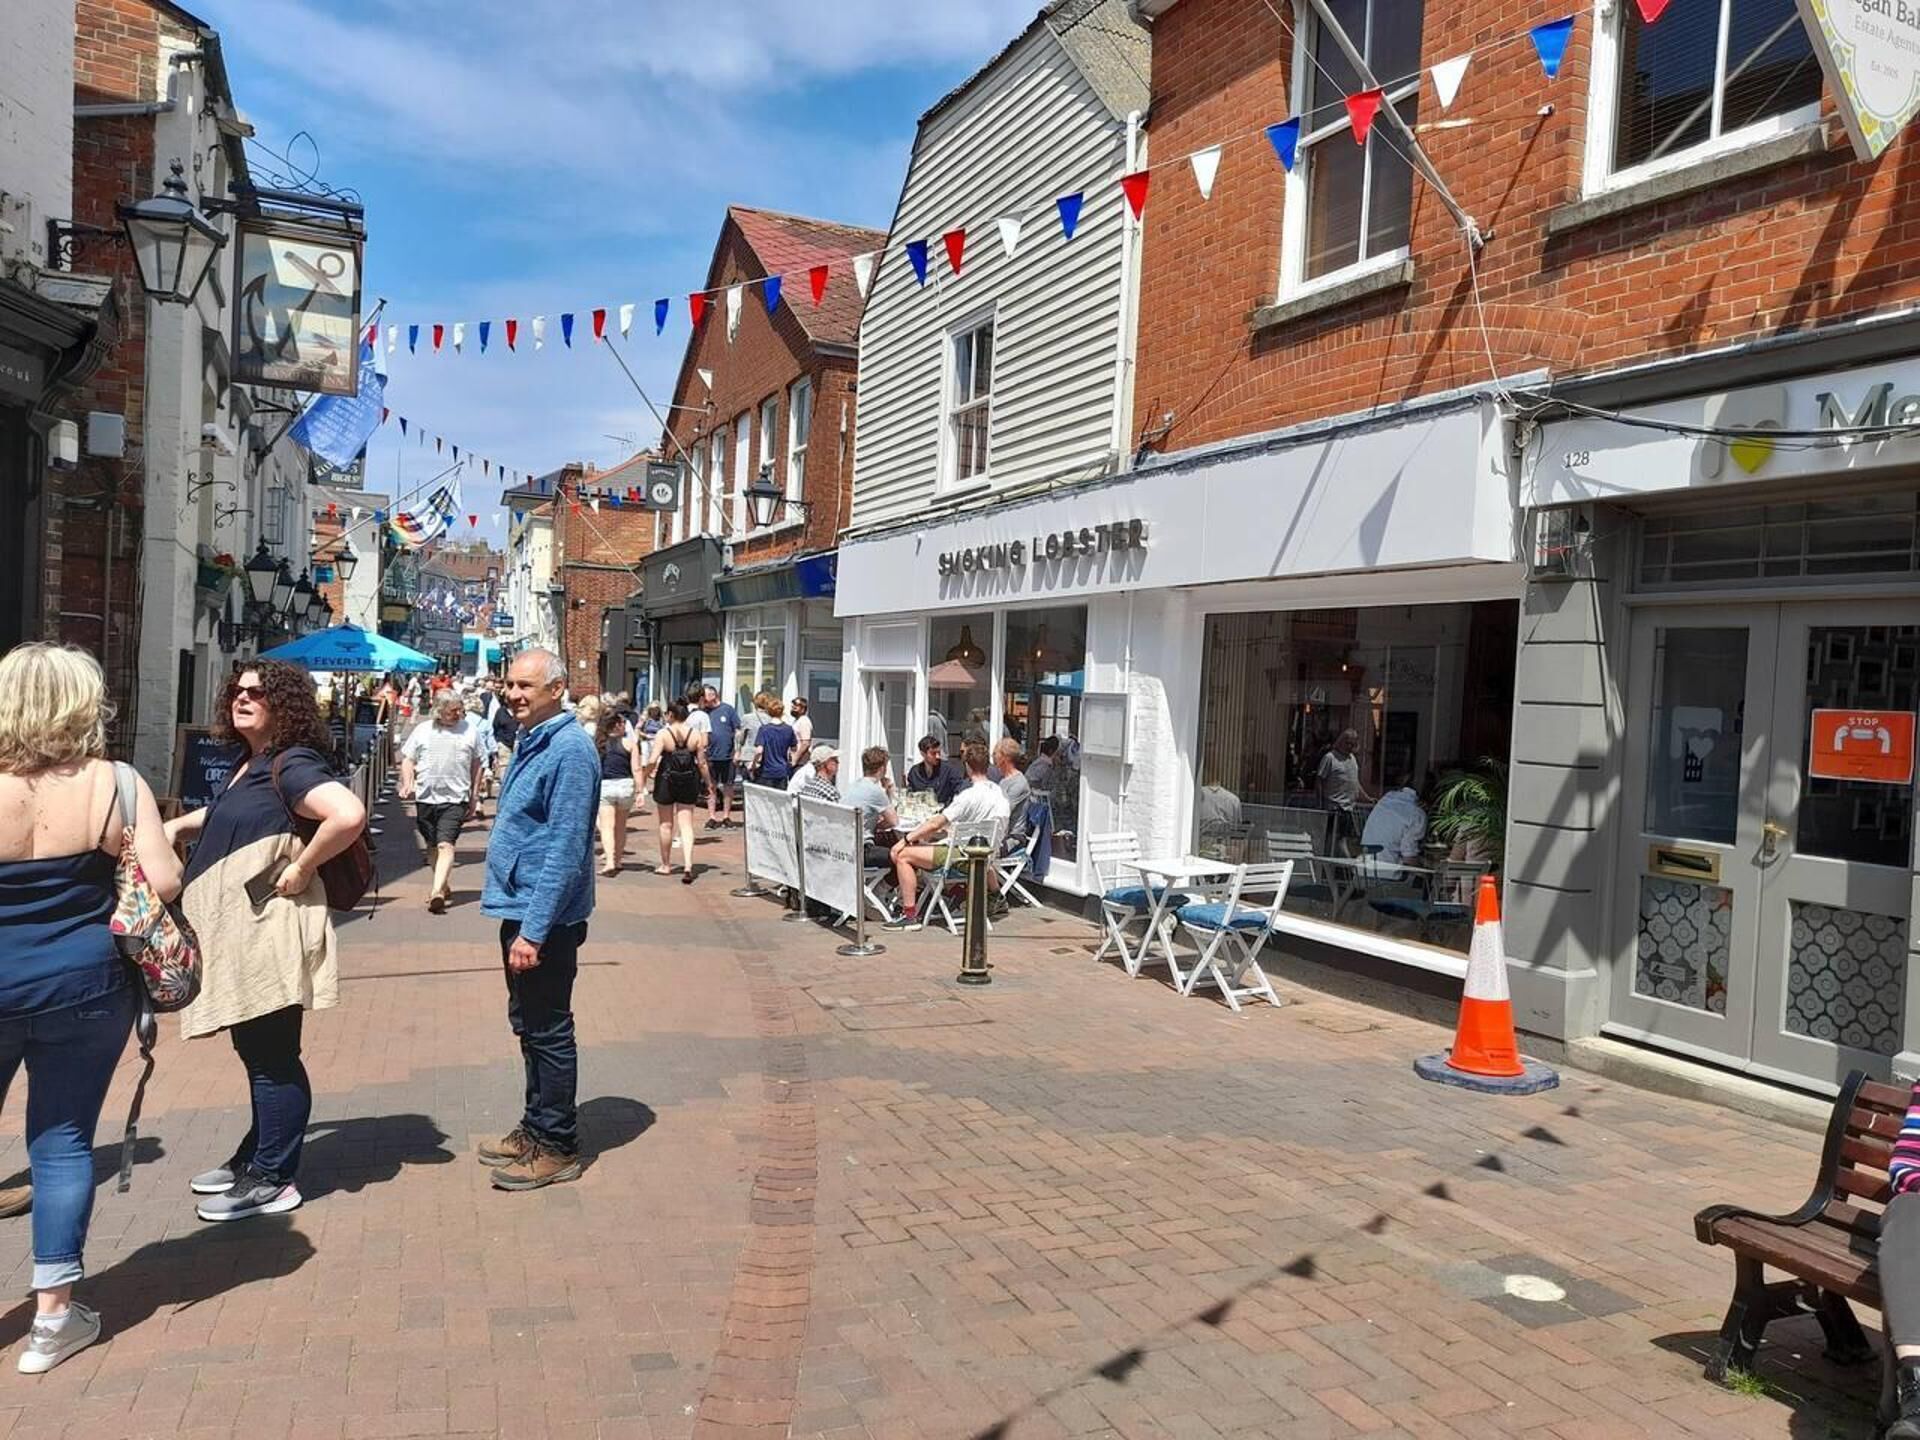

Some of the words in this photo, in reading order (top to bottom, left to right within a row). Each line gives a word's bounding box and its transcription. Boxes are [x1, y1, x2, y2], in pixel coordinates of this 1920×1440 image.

[1855, 0, 1892, 18] gan
[1855, 14, 1886, 39] Estate
[1564, 452, 1590, 468] 128
[938, 540, 1026, 576] SMOKING
[1033, 518, 1148, 563] LOBSTER
[1848, 717, 1879, 726] STOP
